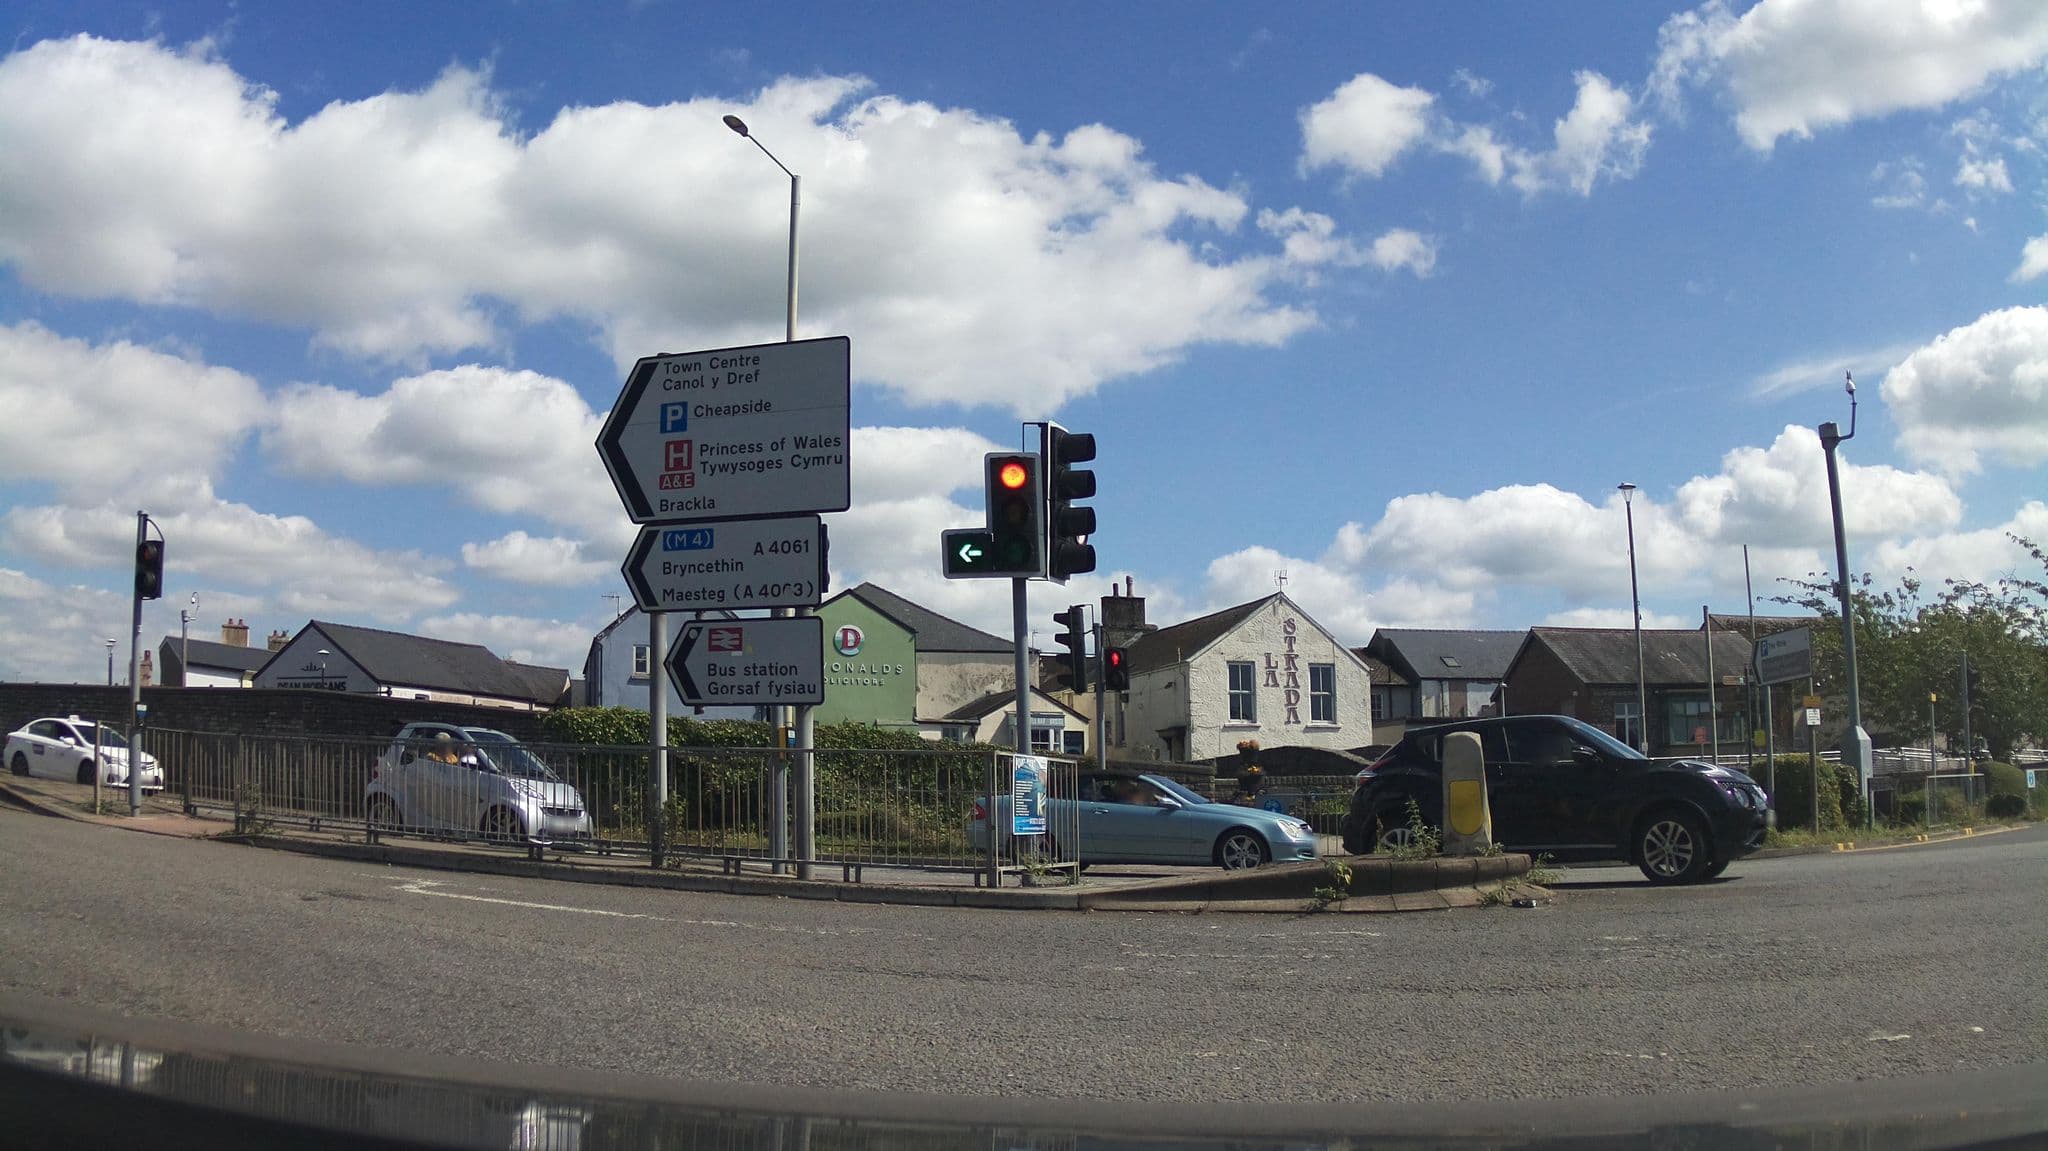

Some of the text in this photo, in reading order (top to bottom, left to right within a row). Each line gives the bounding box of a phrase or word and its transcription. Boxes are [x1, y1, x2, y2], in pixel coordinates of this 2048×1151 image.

[664, 355, 760, 375] Town Centre
[663, 369, 760, 391] Canol y Dref
[667, 400, 772, 430] P Cheapside
[700, 440, 763, 456] Princess
[770, 438, 785, 452] of
[794, 435, 841, 450] Wales
[701, 454, 843, 476] Tywysoges Cymru
[662, 474, 693, 489] A&E
[660, 497, 716, 513] Brackla
[663, 559, 744, 577] Bryncethin
[663, 588, 725, 603] Maesteg
[840, 628, 861, 649] D
[708, 662, 798, 677] Bus station
[1263, 653, 1279, 687] LA
[708, 681, 816, 698] Gorsaf fysiau
